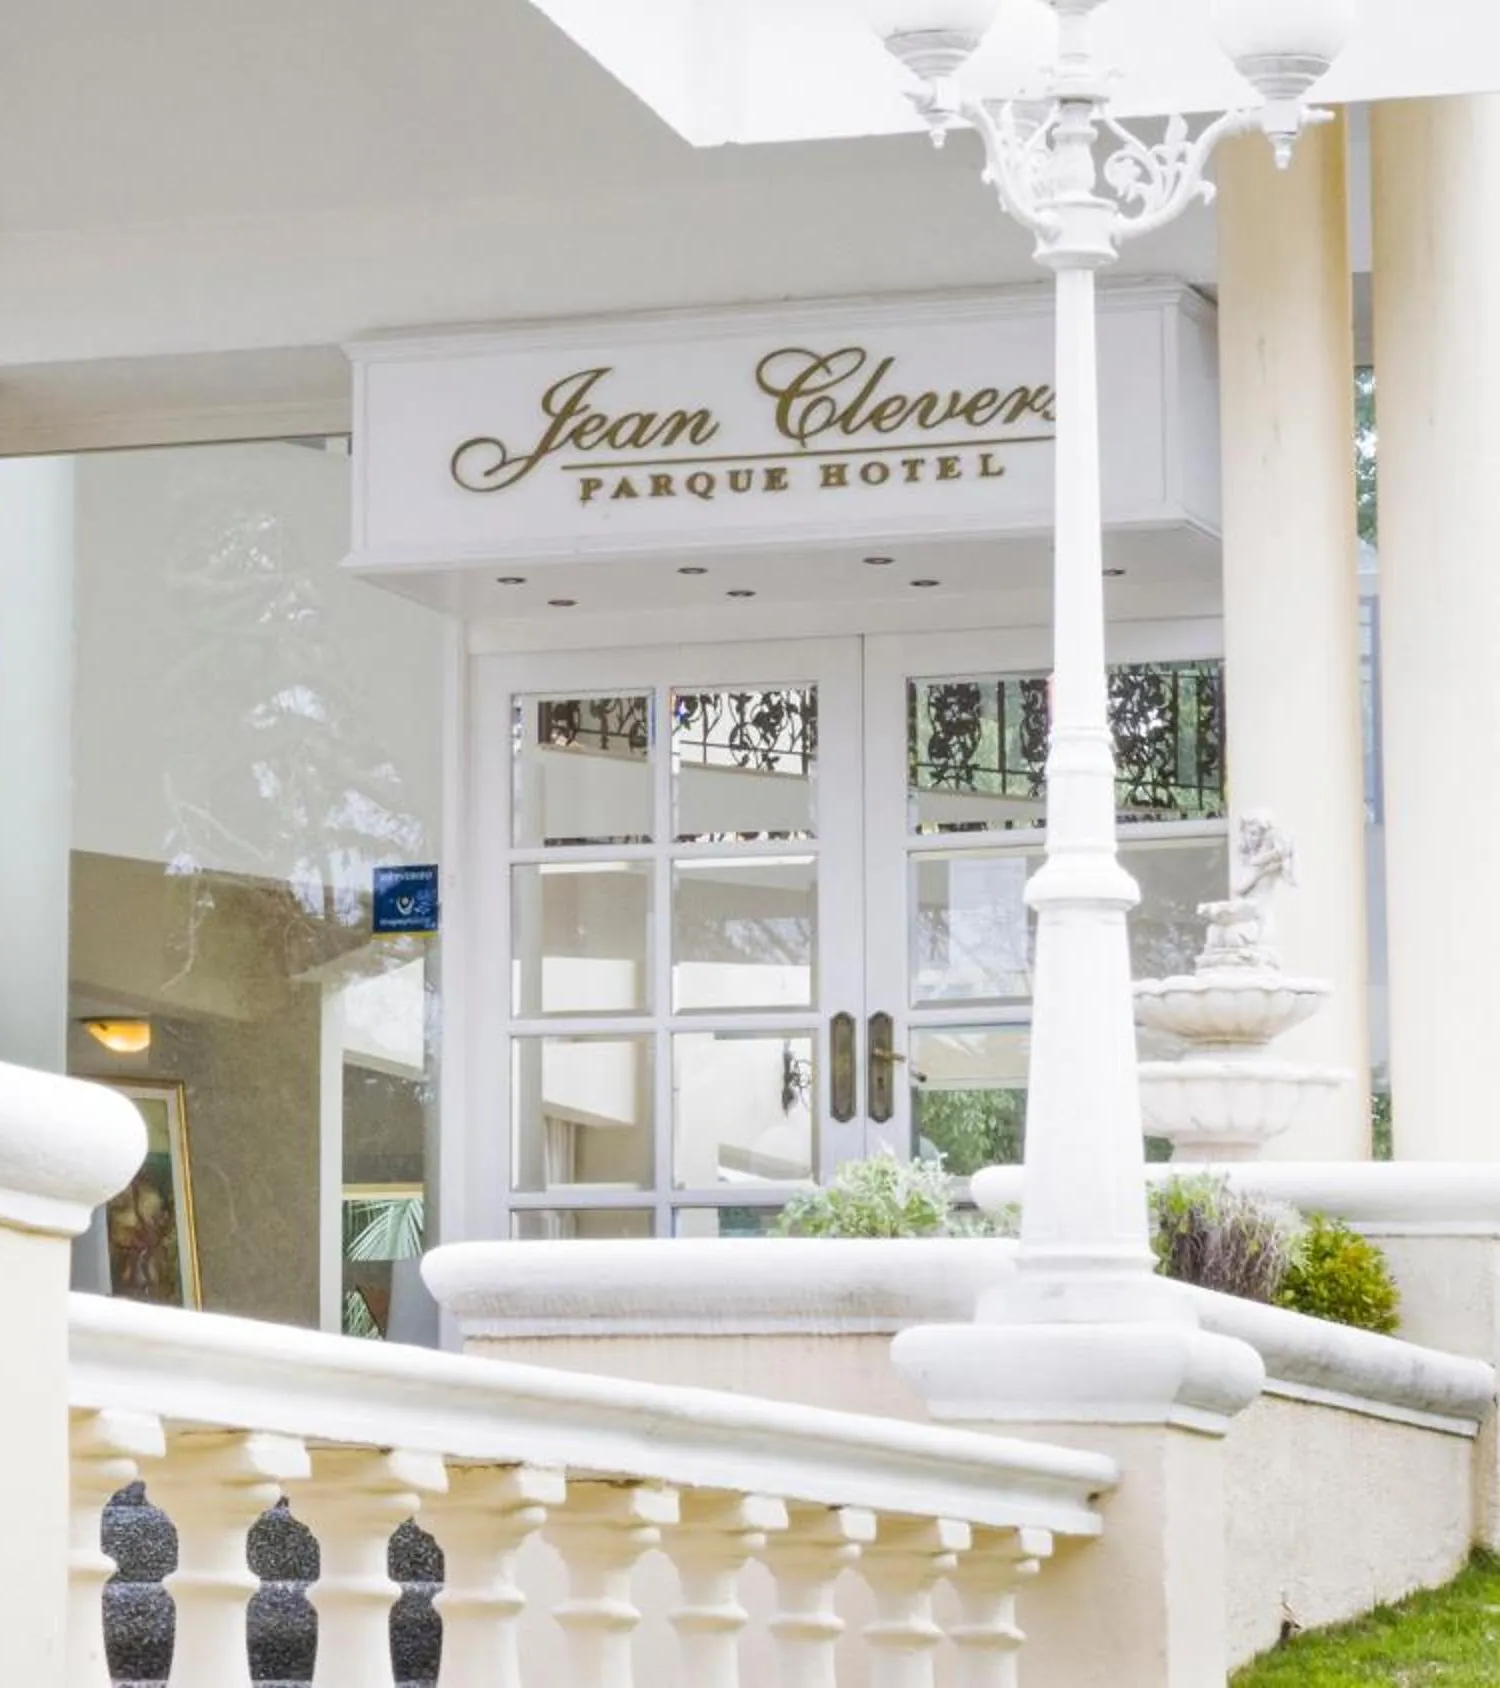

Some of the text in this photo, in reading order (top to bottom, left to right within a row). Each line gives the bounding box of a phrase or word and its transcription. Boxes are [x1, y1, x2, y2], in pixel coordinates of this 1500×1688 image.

[451, 366, 720, 493] Jean
[579, 453, 1005, 504] PARQUE HOTEL
